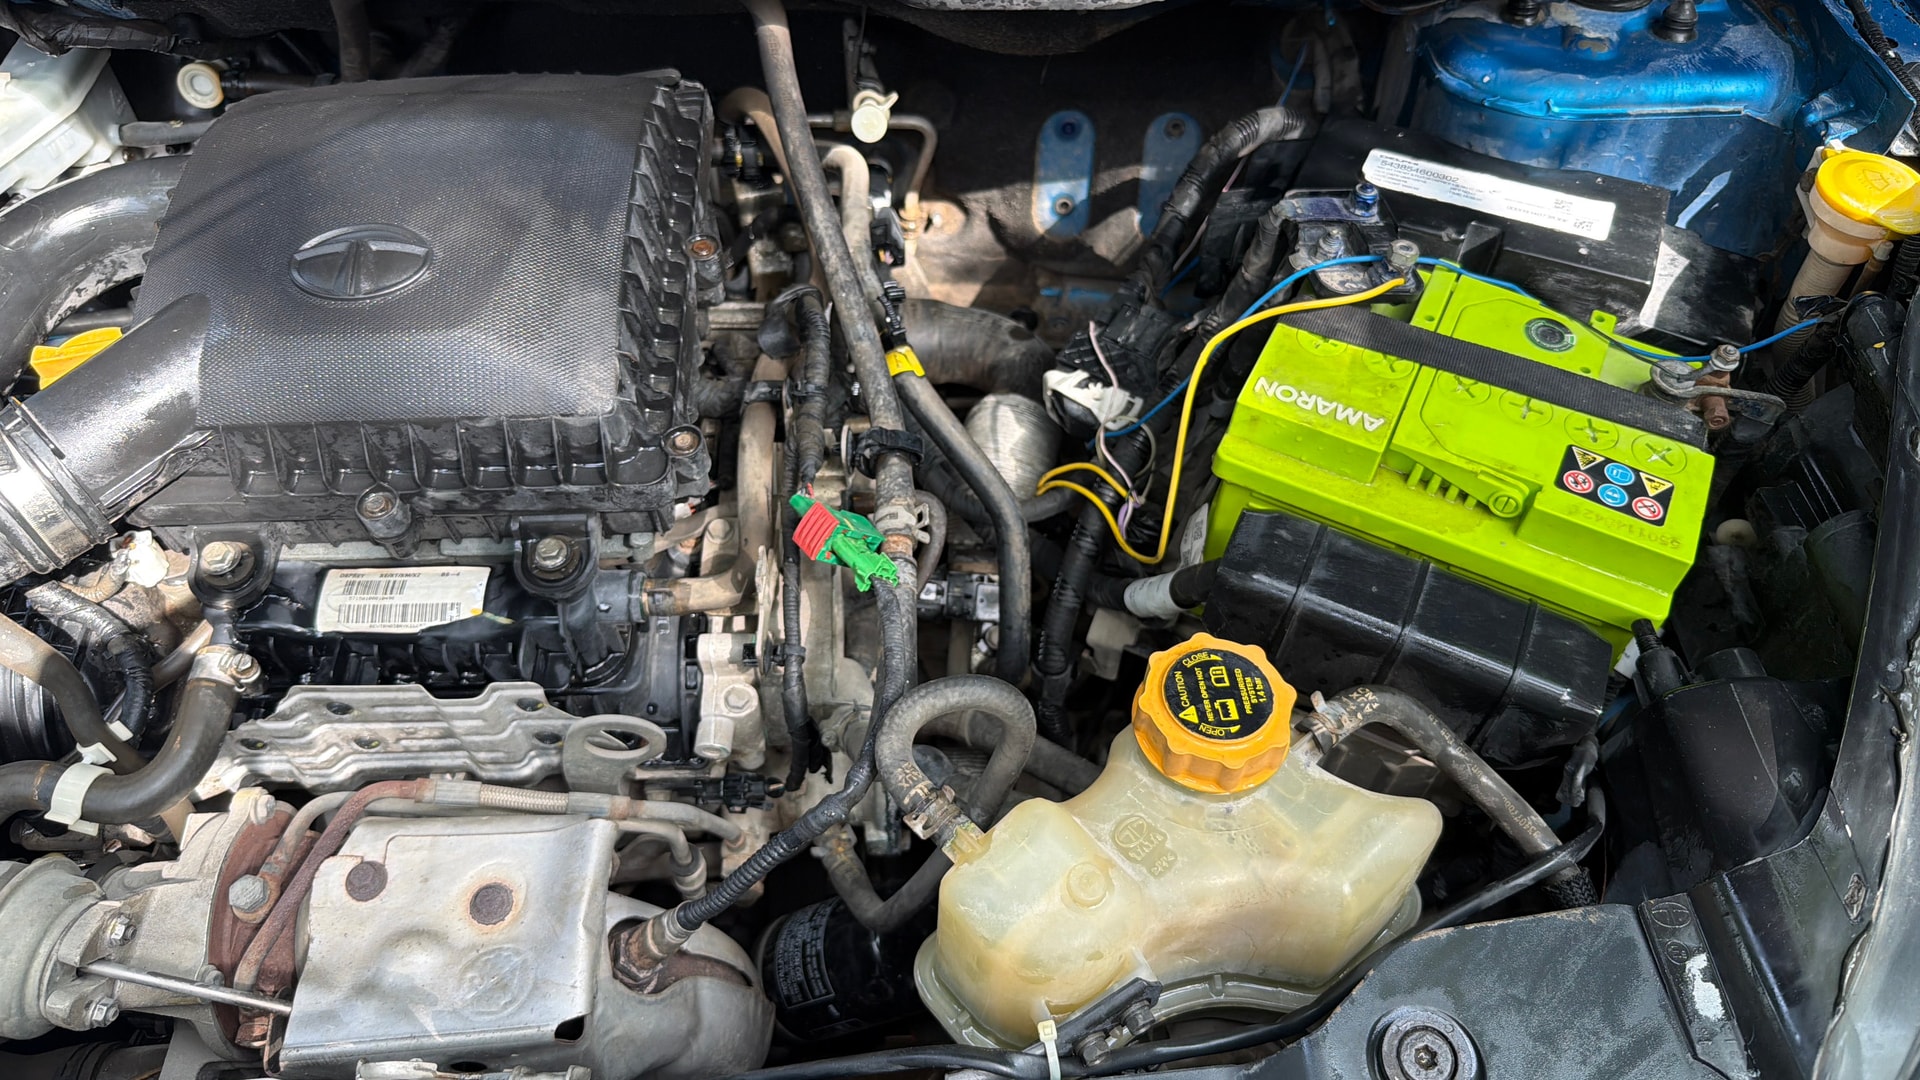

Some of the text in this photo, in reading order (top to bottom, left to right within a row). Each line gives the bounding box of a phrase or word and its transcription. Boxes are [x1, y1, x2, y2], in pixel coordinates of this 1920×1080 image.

[1254, 377, 1385, 432] AMARON
[1182, 652, 1210, 667] CLOSE
[1174, 671, 1190, 707] CAUTION
[1195, 667, 1214, 722] NEVER OPEN HOT
[1234, 668, 1253, 714] PRESSURISED
[1245, 677, 1258, 704] SYSTEM
[1254, 677, 1267, 703] 1.4 bar
[1199, 724, 1225, 736] OPEN
